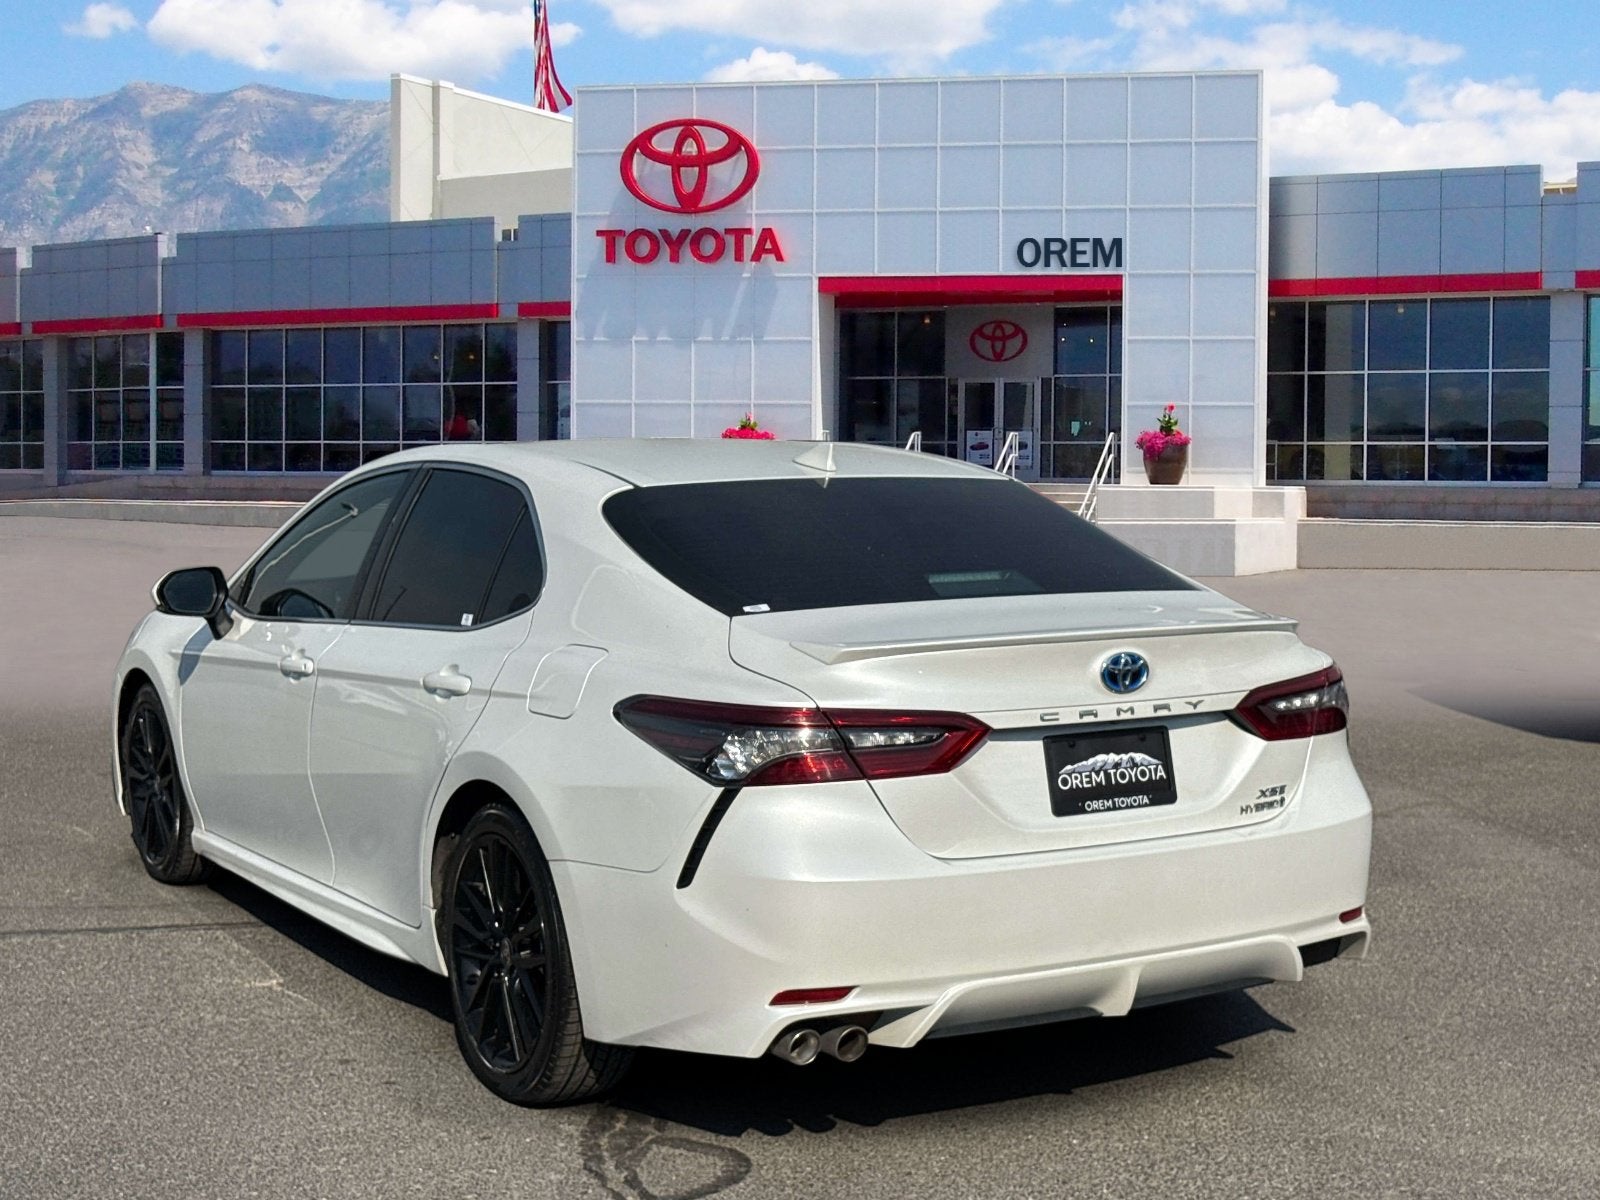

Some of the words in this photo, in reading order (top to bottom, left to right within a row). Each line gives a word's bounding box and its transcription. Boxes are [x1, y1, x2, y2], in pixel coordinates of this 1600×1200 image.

[596, 228, 785, 264] TOYOTA
[1016, 237, 1123, 268] OREM
[1039, 699, 1205, 722] CAMRY
[1057, 770, 1106, 791] OREM
[1107, 764, 1167, 785] TOYOTA
[1084, 798, 1113, 812] OREM
[1113, 794, 1150, 808] TOYOTA
